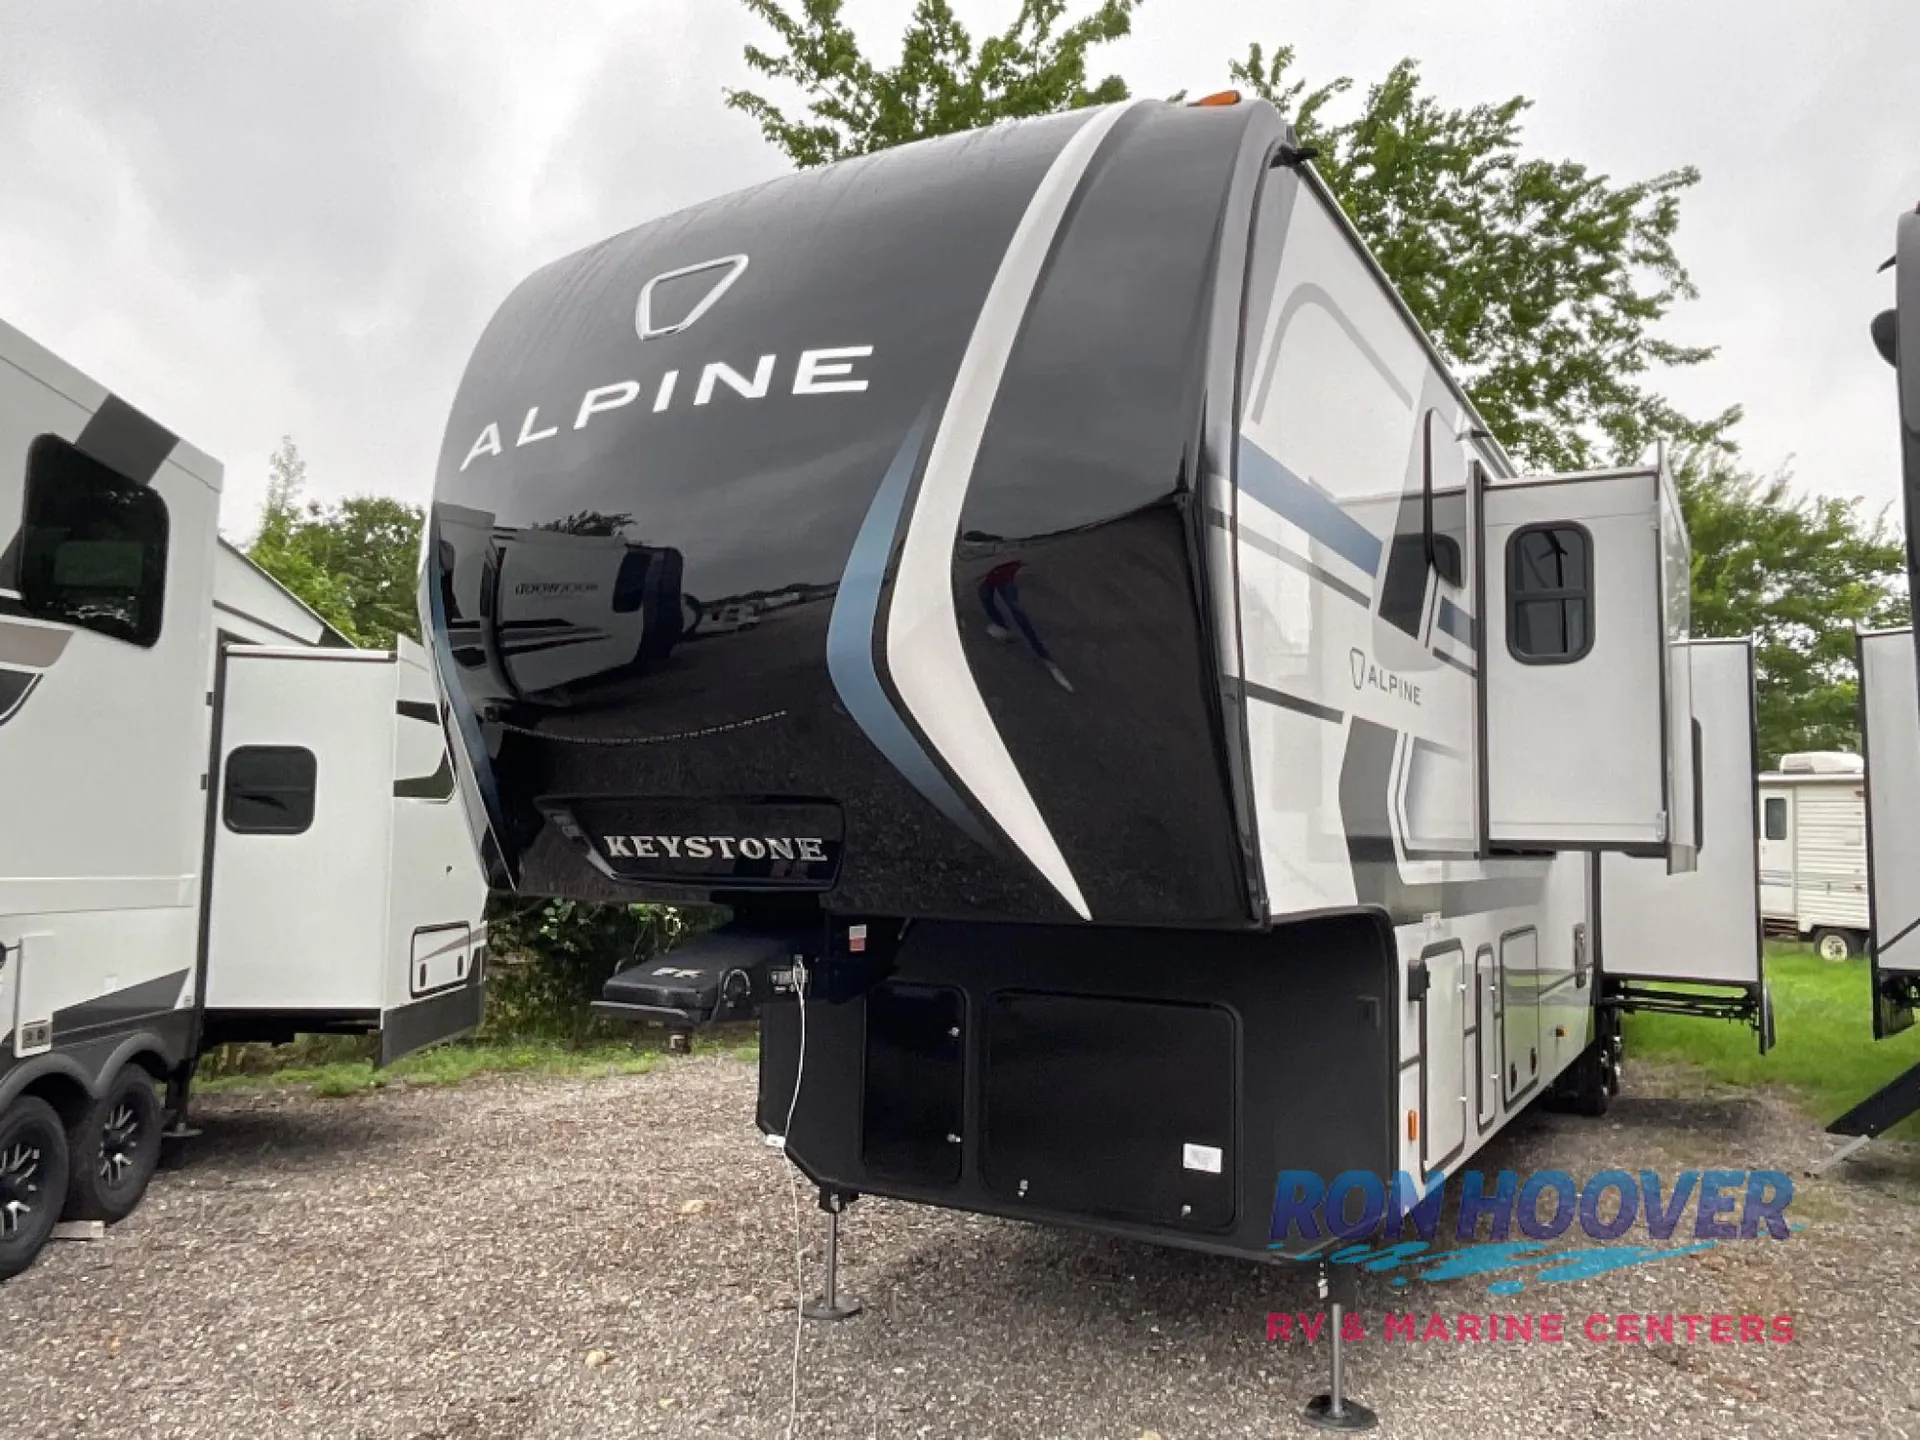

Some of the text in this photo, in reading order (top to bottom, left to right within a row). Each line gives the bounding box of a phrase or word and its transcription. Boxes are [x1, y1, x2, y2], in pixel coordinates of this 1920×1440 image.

[459, 344, 875, 472] ALPINE
[1367, 664, 1422, 706] ALPINE
[604, 835, 828, 861] KEYSTONE
